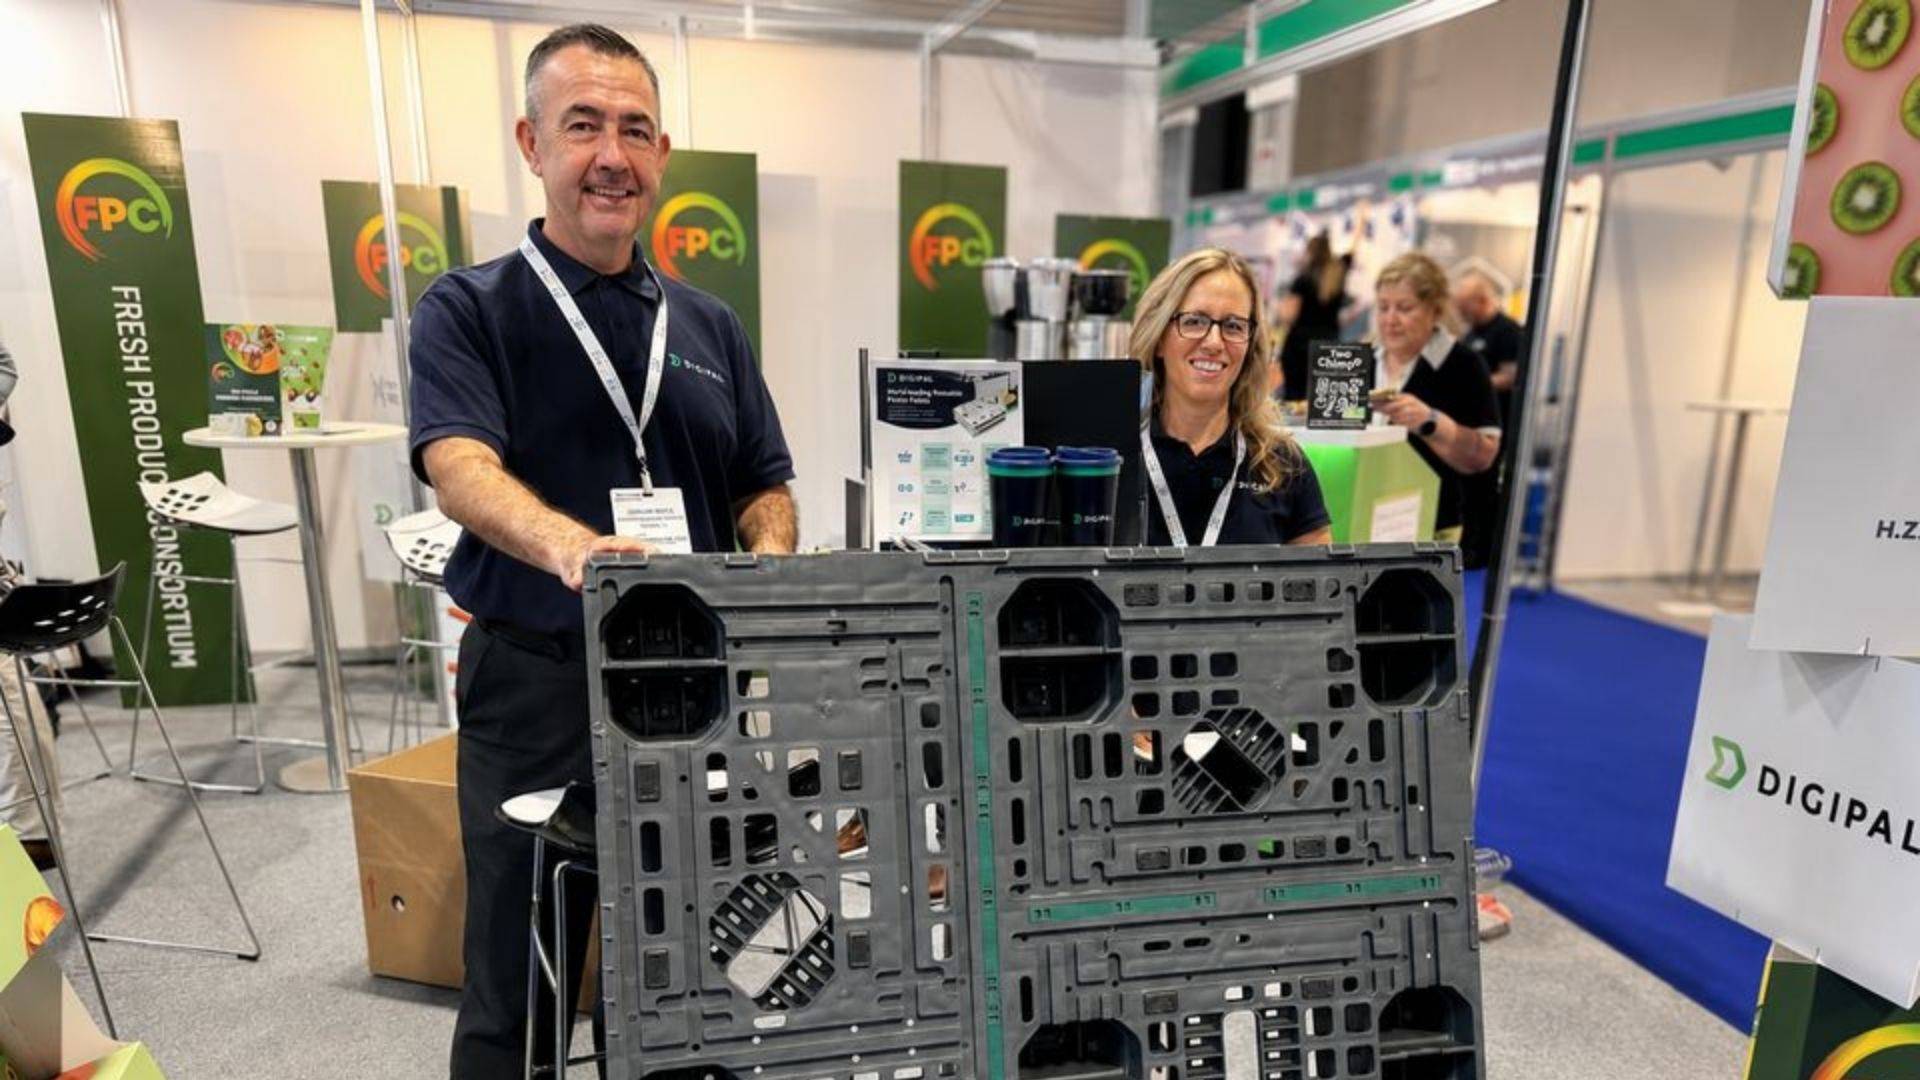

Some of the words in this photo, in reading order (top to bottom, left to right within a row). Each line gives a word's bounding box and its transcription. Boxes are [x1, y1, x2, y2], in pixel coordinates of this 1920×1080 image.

[73, 196, 161, 233] FPC
[667, 226, 735, 259] FPC
[924, 235, 983, 267] FPC
[111, 285, 152, 372] FRESH
[126, 381, 169, 484] PRODUC
[1756, 764, 1920, 855] DIGIPAL
